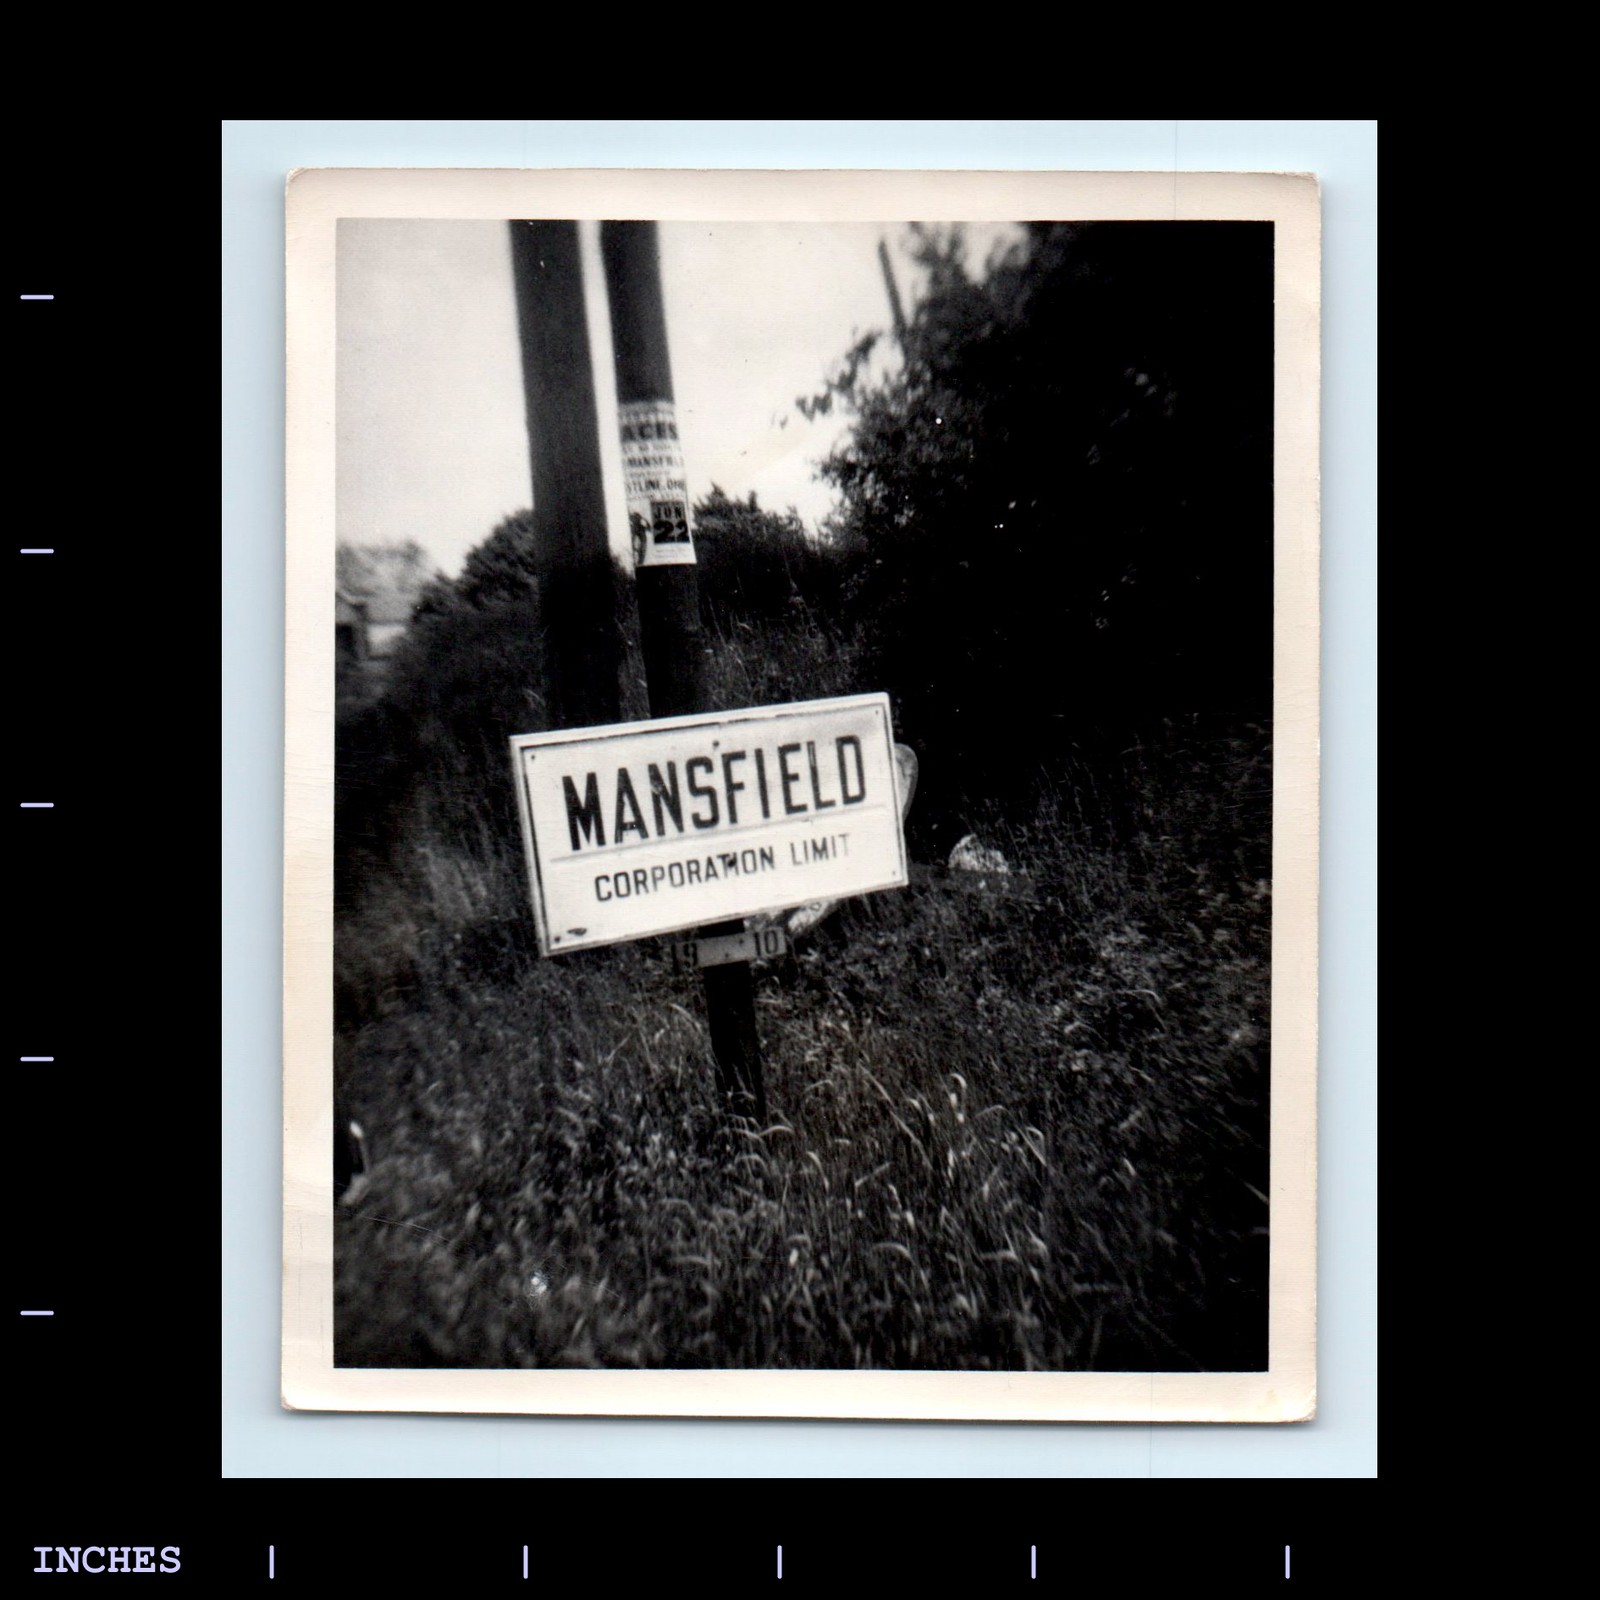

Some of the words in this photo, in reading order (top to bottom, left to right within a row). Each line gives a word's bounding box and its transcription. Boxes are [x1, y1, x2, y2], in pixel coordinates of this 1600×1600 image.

[653, 519, 690, 543] 22
[562, 735, 866, 851] MANSFIELD
[594, 845, 776, 902] CORPORATION
[790, 833, 851, 866] LIMIT
[753, 929, 780, 956] 10
